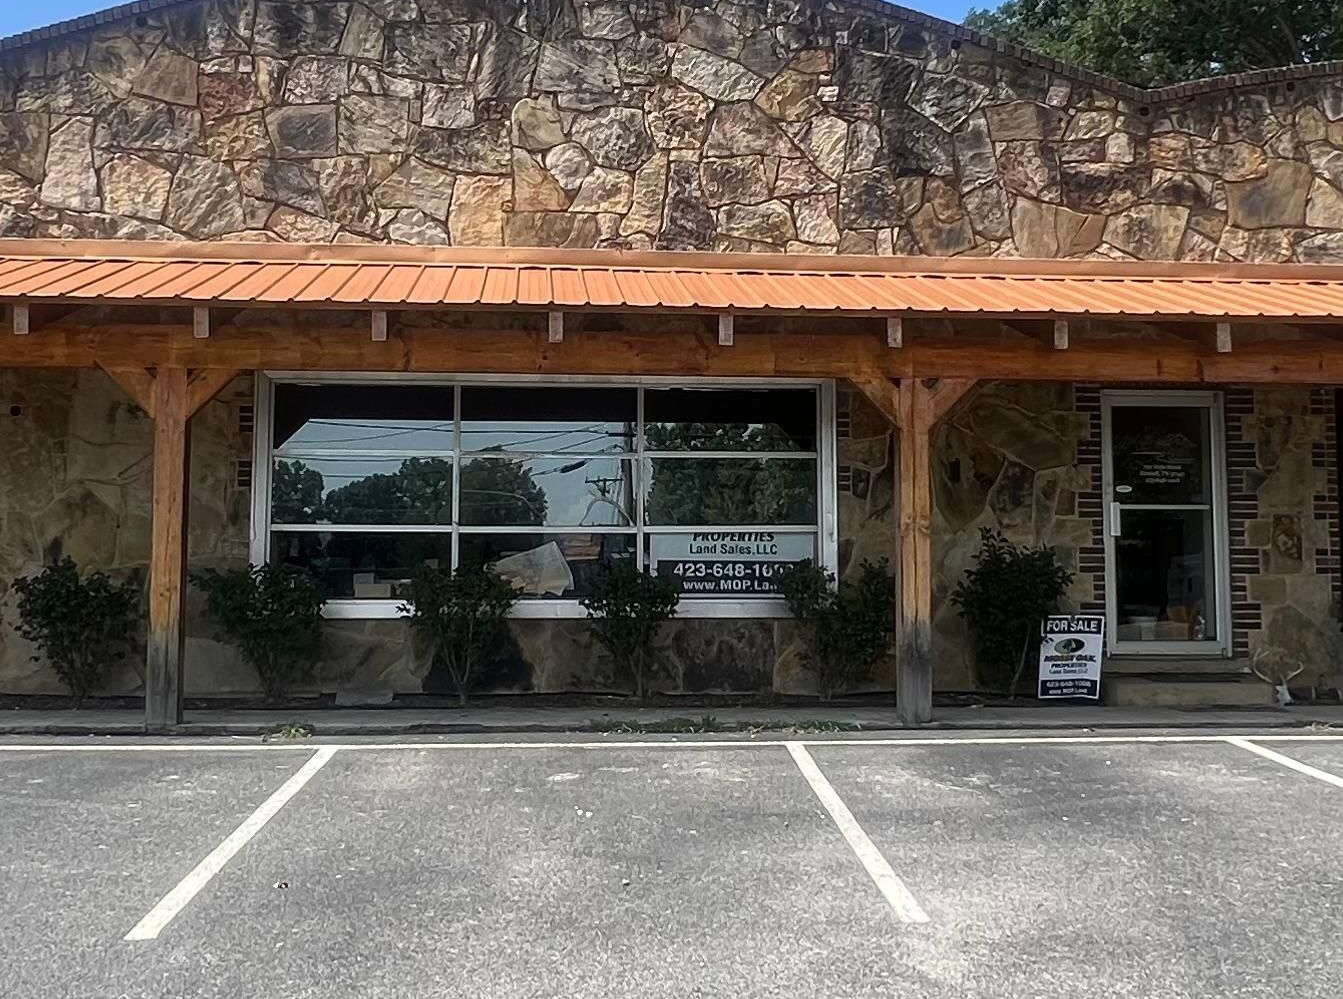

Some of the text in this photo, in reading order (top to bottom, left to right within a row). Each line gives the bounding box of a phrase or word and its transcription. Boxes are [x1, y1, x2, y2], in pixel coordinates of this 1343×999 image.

[692, 532, 775, 542] PROPERTIES
[689, 543, 717, 554] Land
[1047, 620, 1098, 631] FOR SALE
